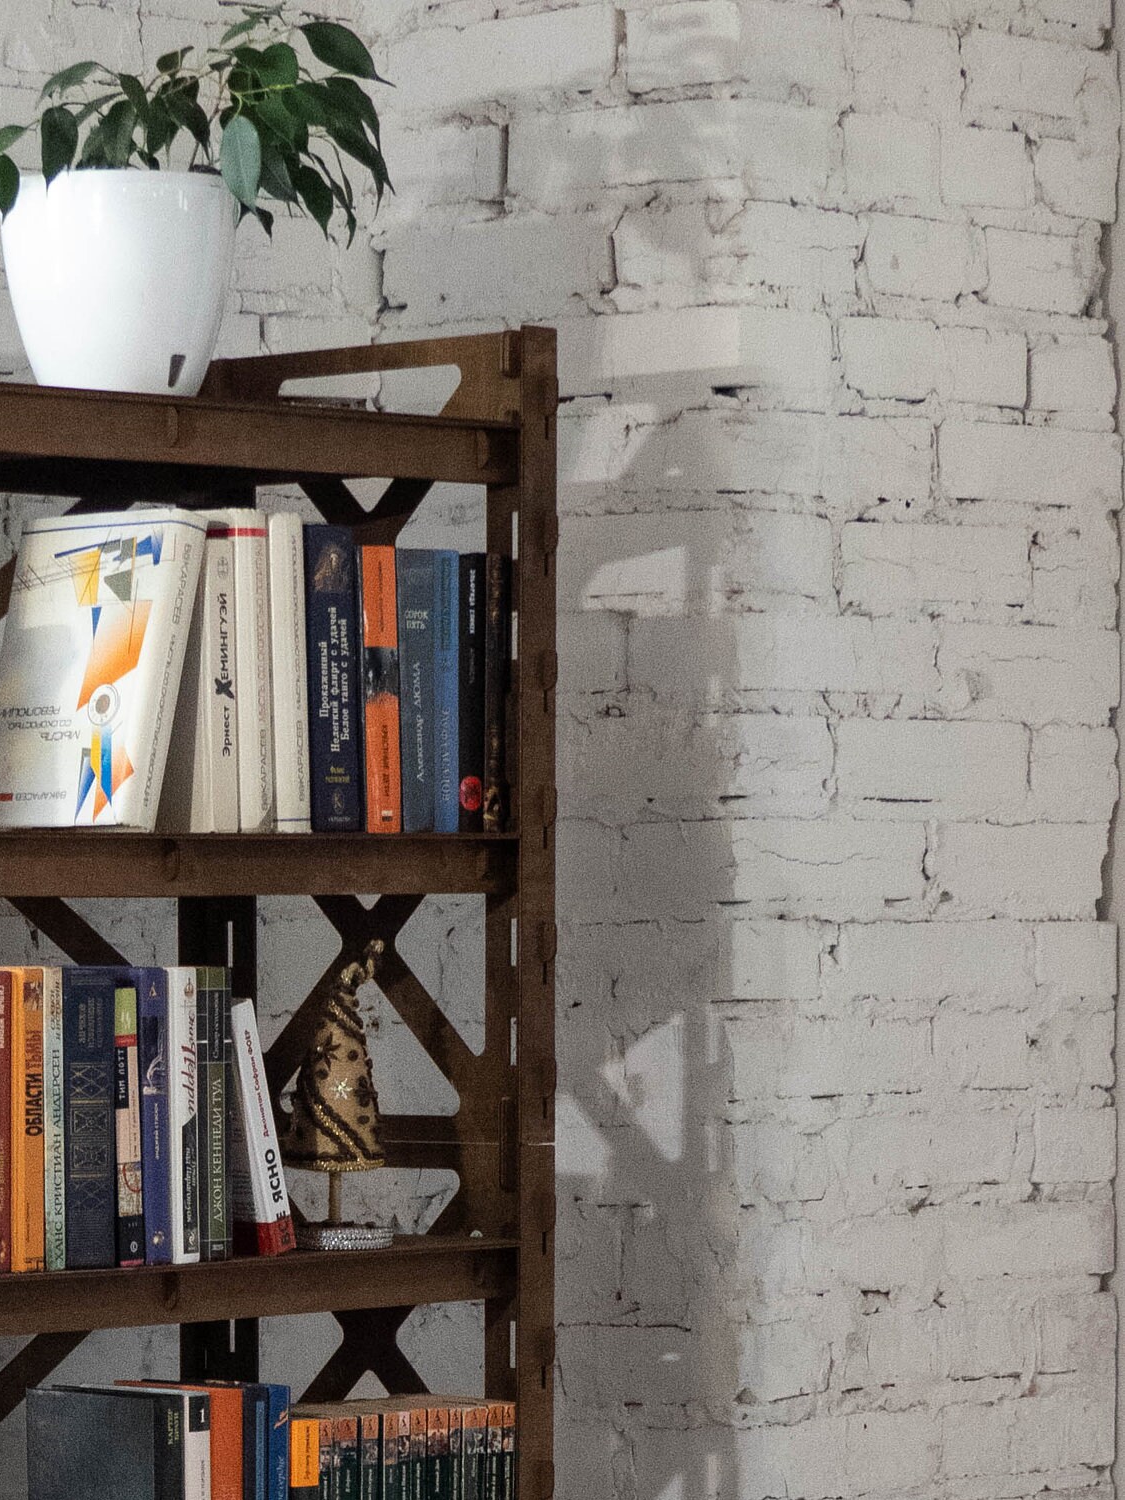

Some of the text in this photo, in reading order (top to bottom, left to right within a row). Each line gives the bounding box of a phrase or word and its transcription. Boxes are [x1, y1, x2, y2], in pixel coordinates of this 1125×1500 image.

[213, 592, 235, 700] ХЕМИНГУЭЙ
[329, 606, 340, 645] удачей
[338, 618, 350, 656] удачей
[318, 641, 330, 718] Прокаженный
[330, 661, 340, 696] флирт
[341, 672, 350, 703] танго
[221, 705, 233, 757] Эрнест
[329, 701, 341, 753] Нелегкий
[340, 708, 350, 740] Белое
[412, 660, 425, 783] Александр ДЮМА
[25, 1029, 43, 1136] ОБЛАСТИ ТЬМЫ
[117, 1048, 126, 1101] ТИМ ЛОТТ
[242, 1028, 270, 1138] Джонатан Сафран ФОЕР
[50, 1048, 63, 1262] ХАНС КРИСТИАН АНДЕРСЕН
[211, 1078, 223, 1222] ДЖОН КЕННЕДИ ТУЛ
[264, 1148, 291, 1246] ВСЕ ЯСНО
[166, 1408, 174, 1446] КАРТЕР
[198, 1407, 206, 1424] 1
